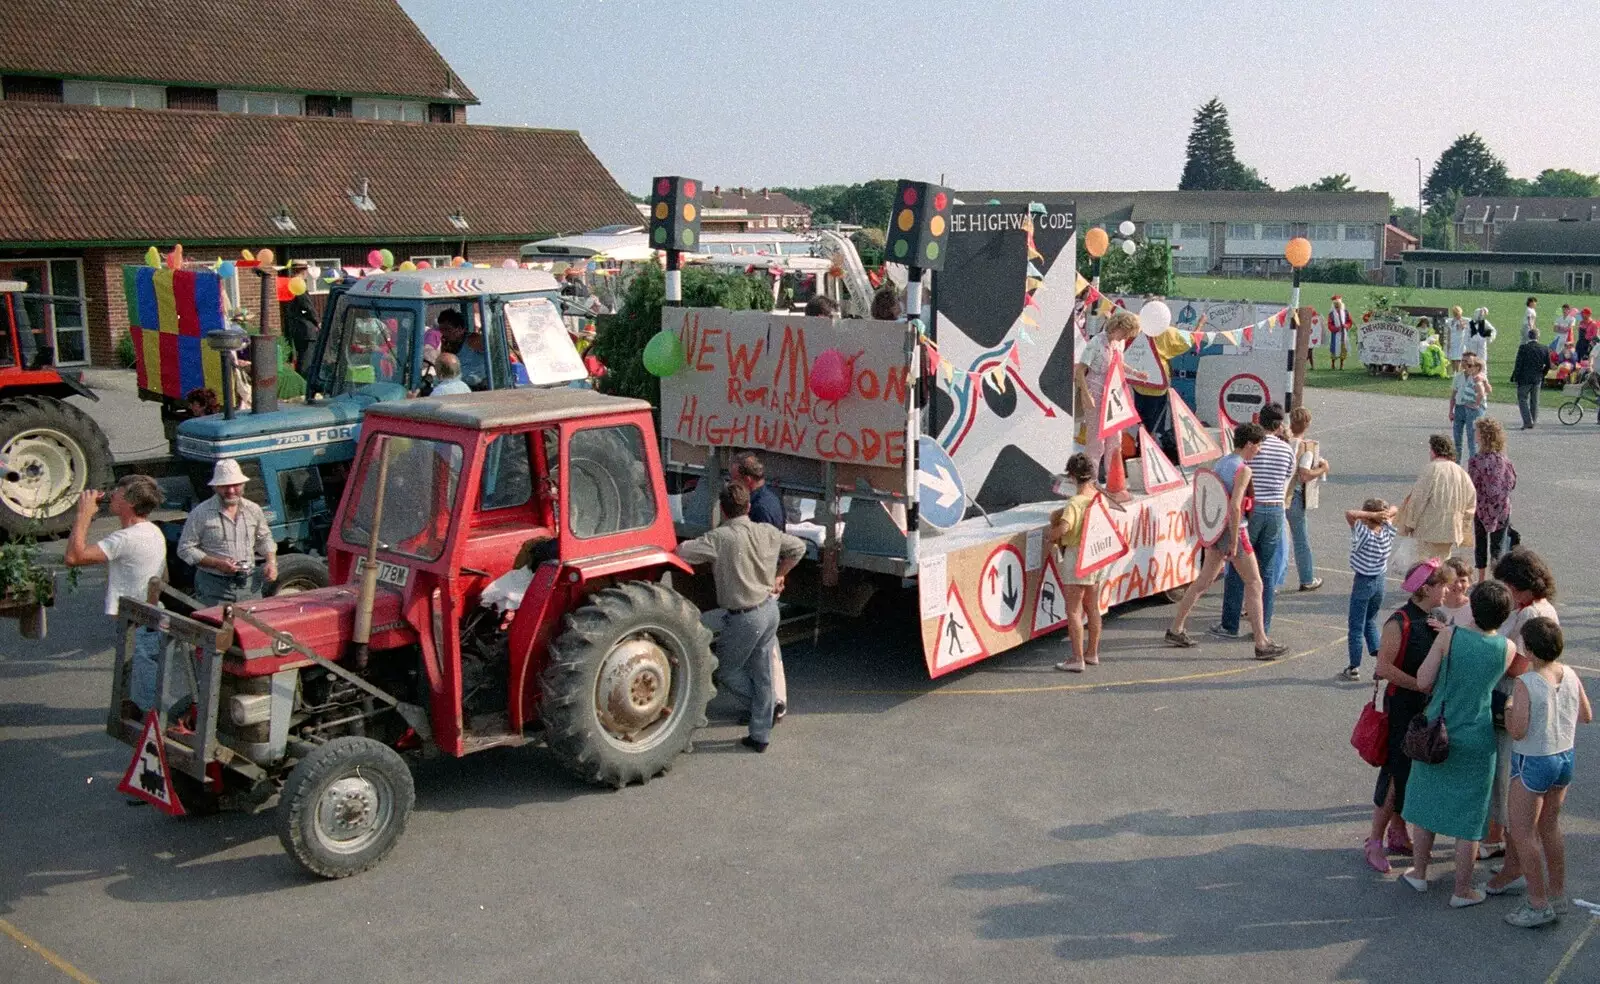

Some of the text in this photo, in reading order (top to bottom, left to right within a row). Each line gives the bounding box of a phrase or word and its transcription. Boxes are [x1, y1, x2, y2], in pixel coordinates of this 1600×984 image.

[950, 214, 966, 232] HE
[1040, 213, 1073, 229] CODE
[680, 312, 909, 405] NEW MTON
[1230, 384, 1260, 393] STOP
[277, 427, 351, 444] 7700 FOR
[677, 394, 905, 466] HIGHWAY CODE
[1131, 503, 1195, 549] MILTON
[1100, 541, 1201, 609] OTARACT
